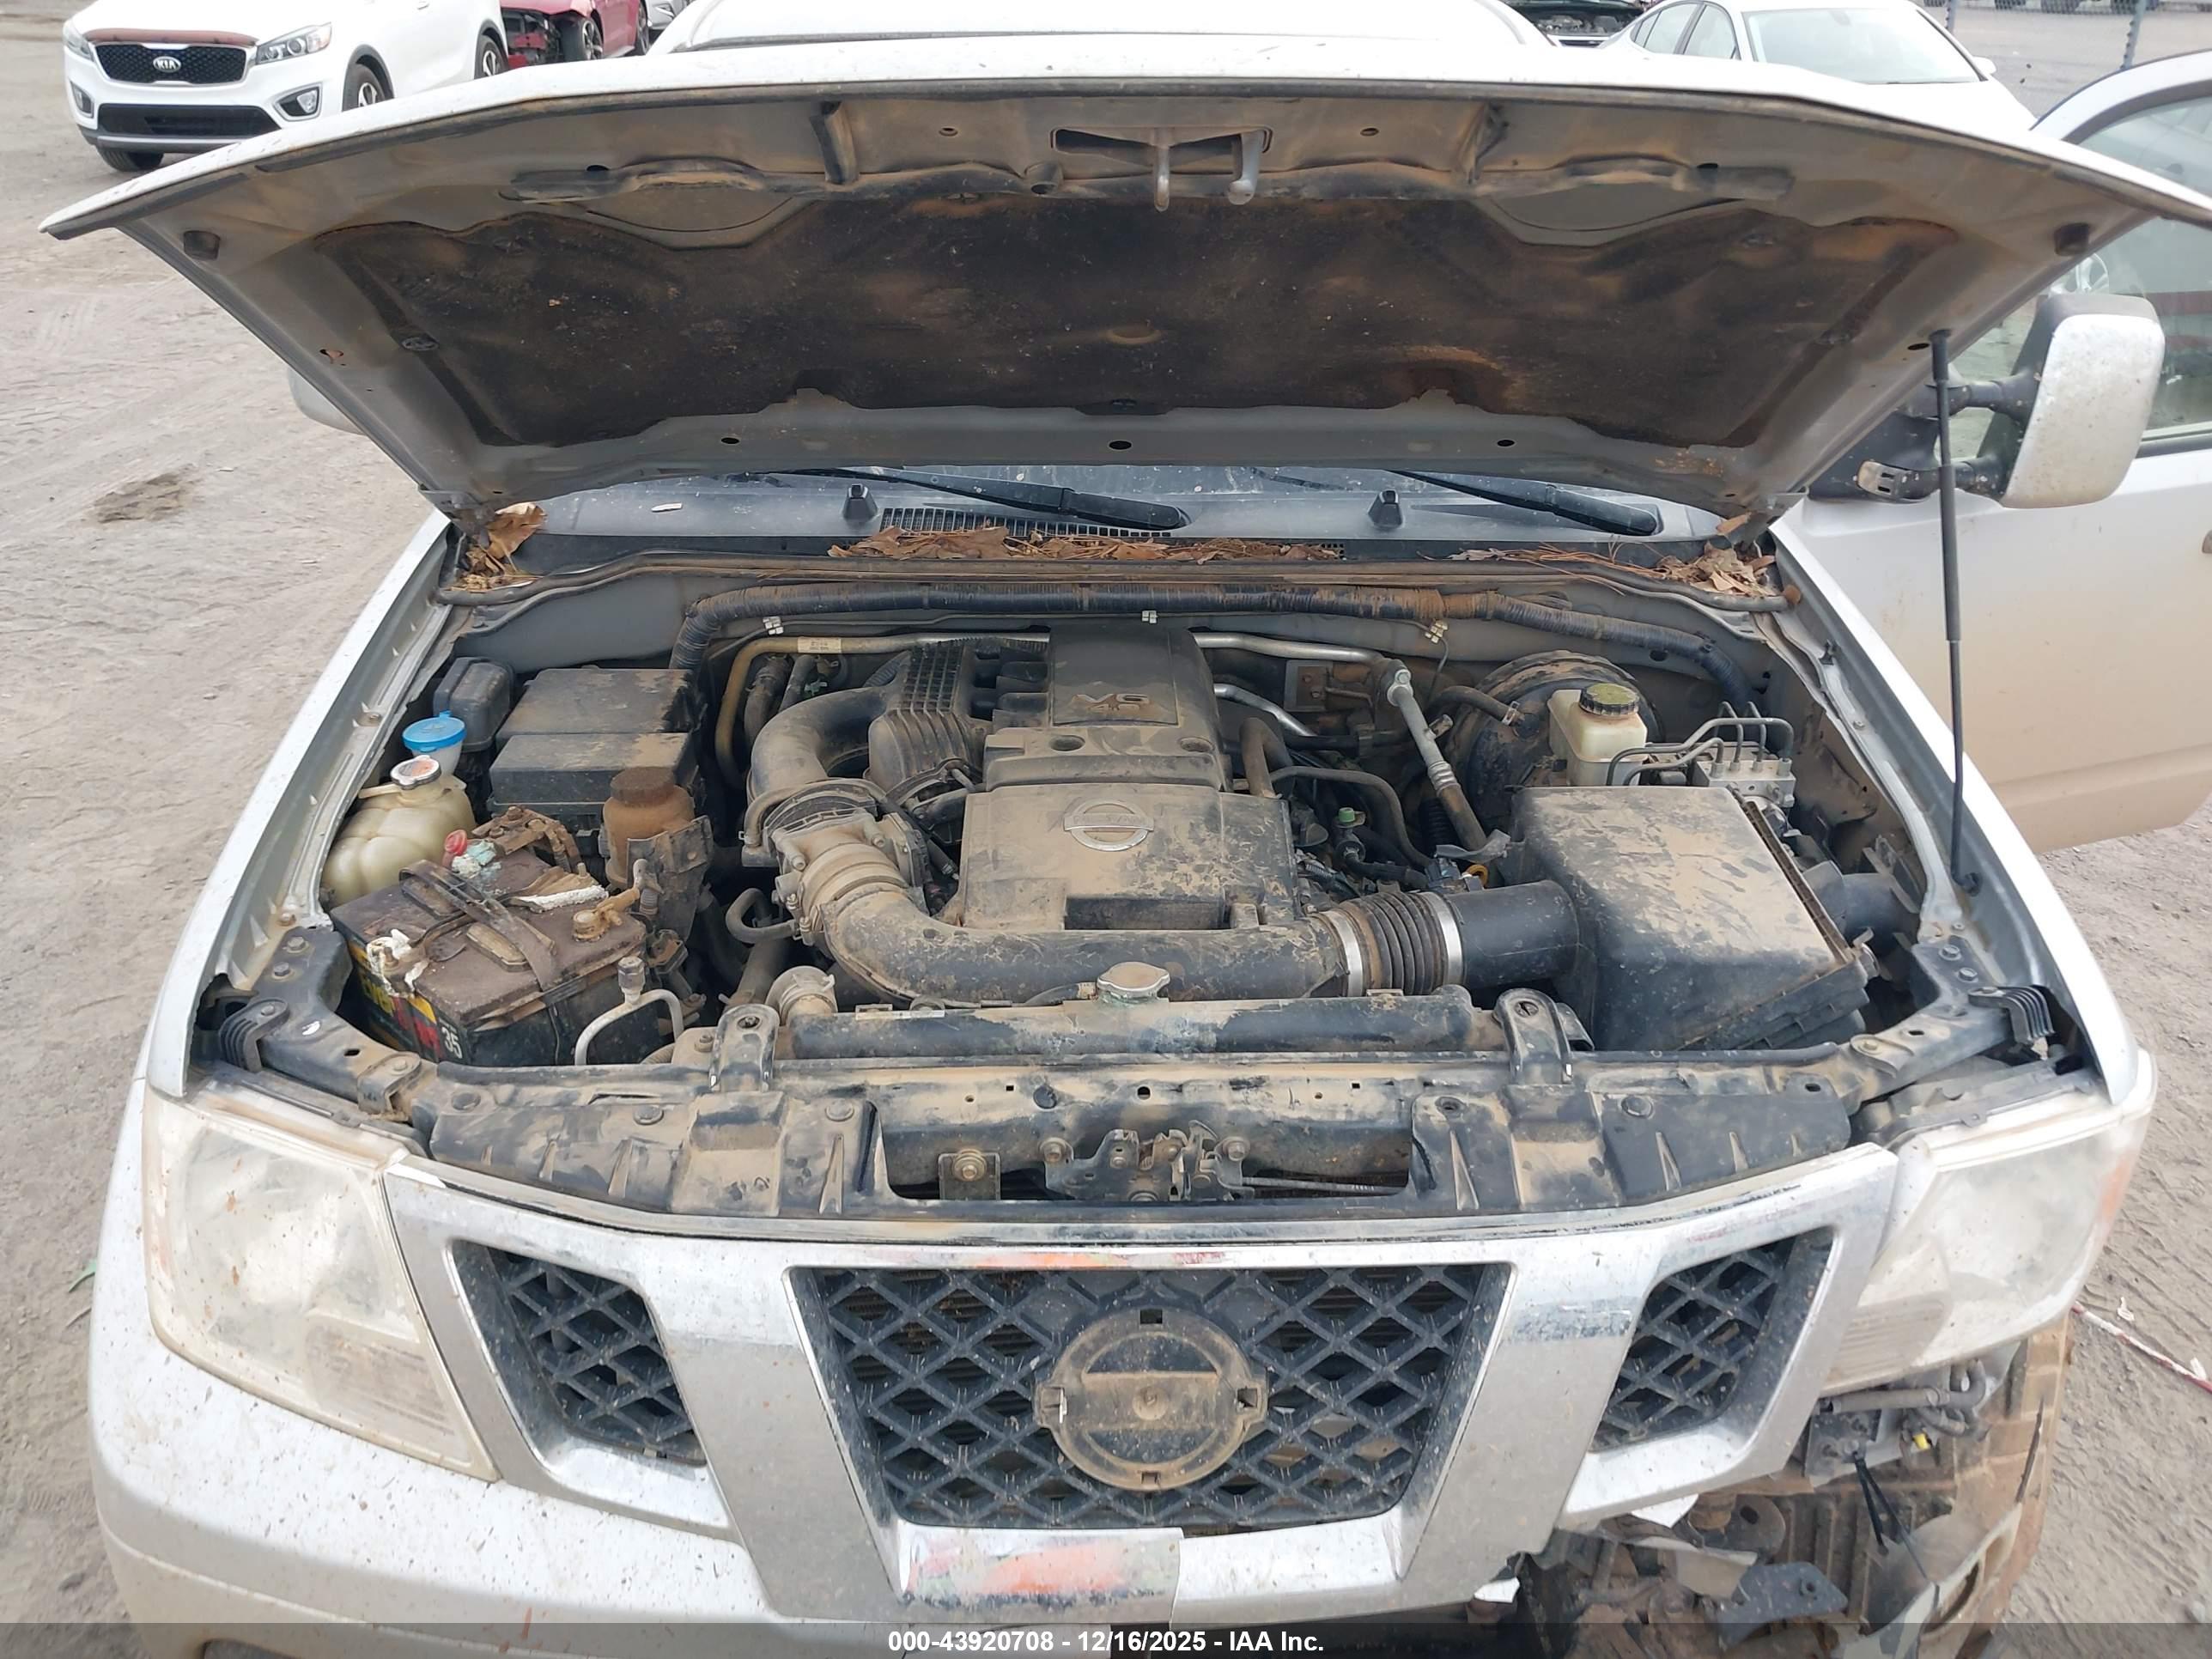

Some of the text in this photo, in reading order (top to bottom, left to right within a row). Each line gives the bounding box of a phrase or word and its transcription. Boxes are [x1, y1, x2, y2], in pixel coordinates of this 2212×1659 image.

[155, 59, 179, 70] KIA
[1072, 693, 1150, 704] V6
[441, 1026, 463, 1059] 35
